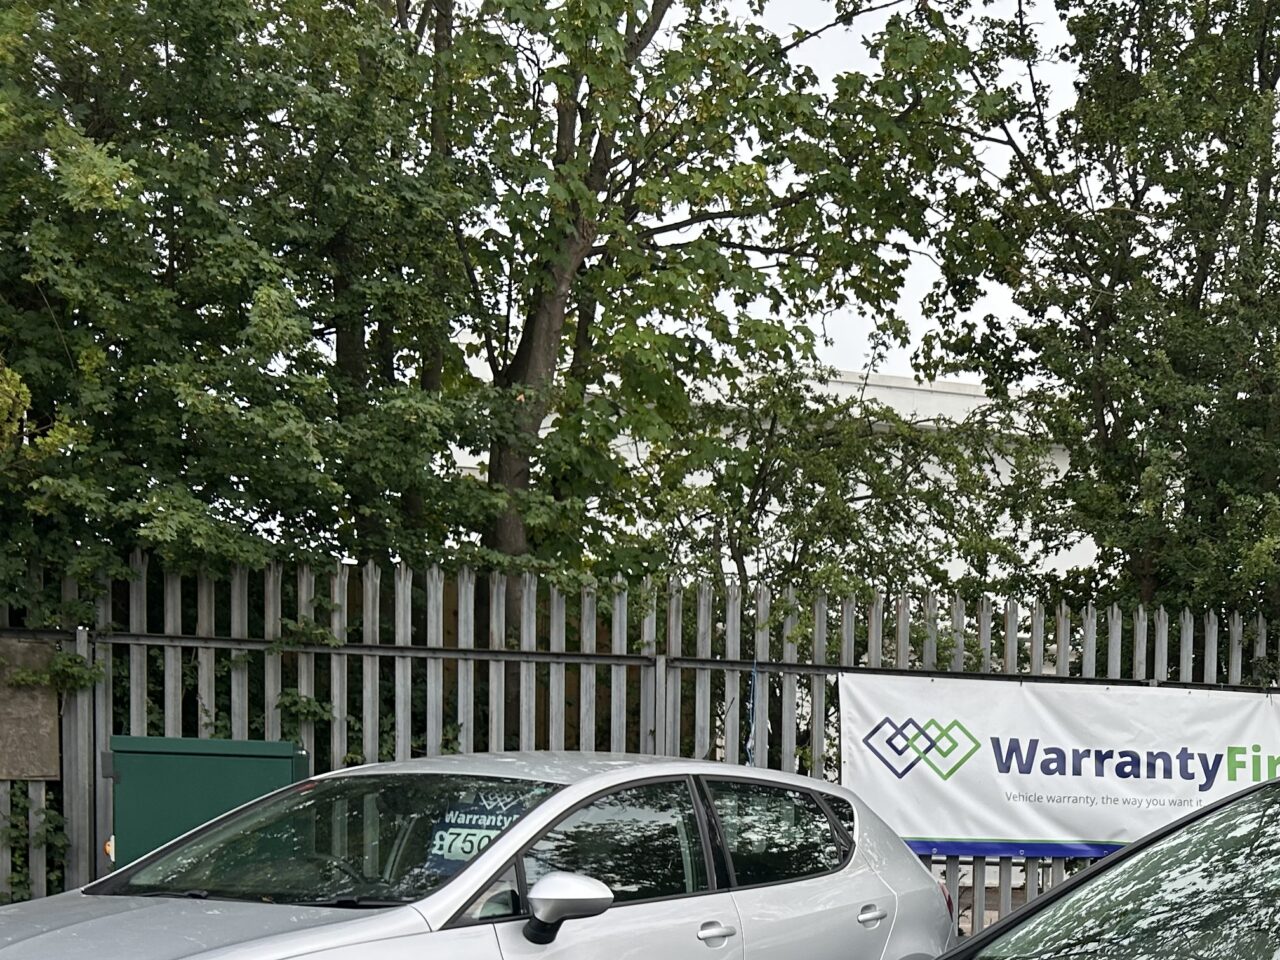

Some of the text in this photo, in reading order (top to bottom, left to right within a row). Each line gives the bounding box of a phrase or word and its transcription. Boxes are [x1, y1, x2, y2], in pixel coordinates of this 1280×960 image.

[1005, 791, 1043, 803] Vehicle
[1046, 794, 1098, 807] warranty,
[1101, 796, 1119, 805] the
[1121, 798, 1143, 808] way
[1145, 798, 1165, 808] you
[1168, 798, 1193, 807] want
